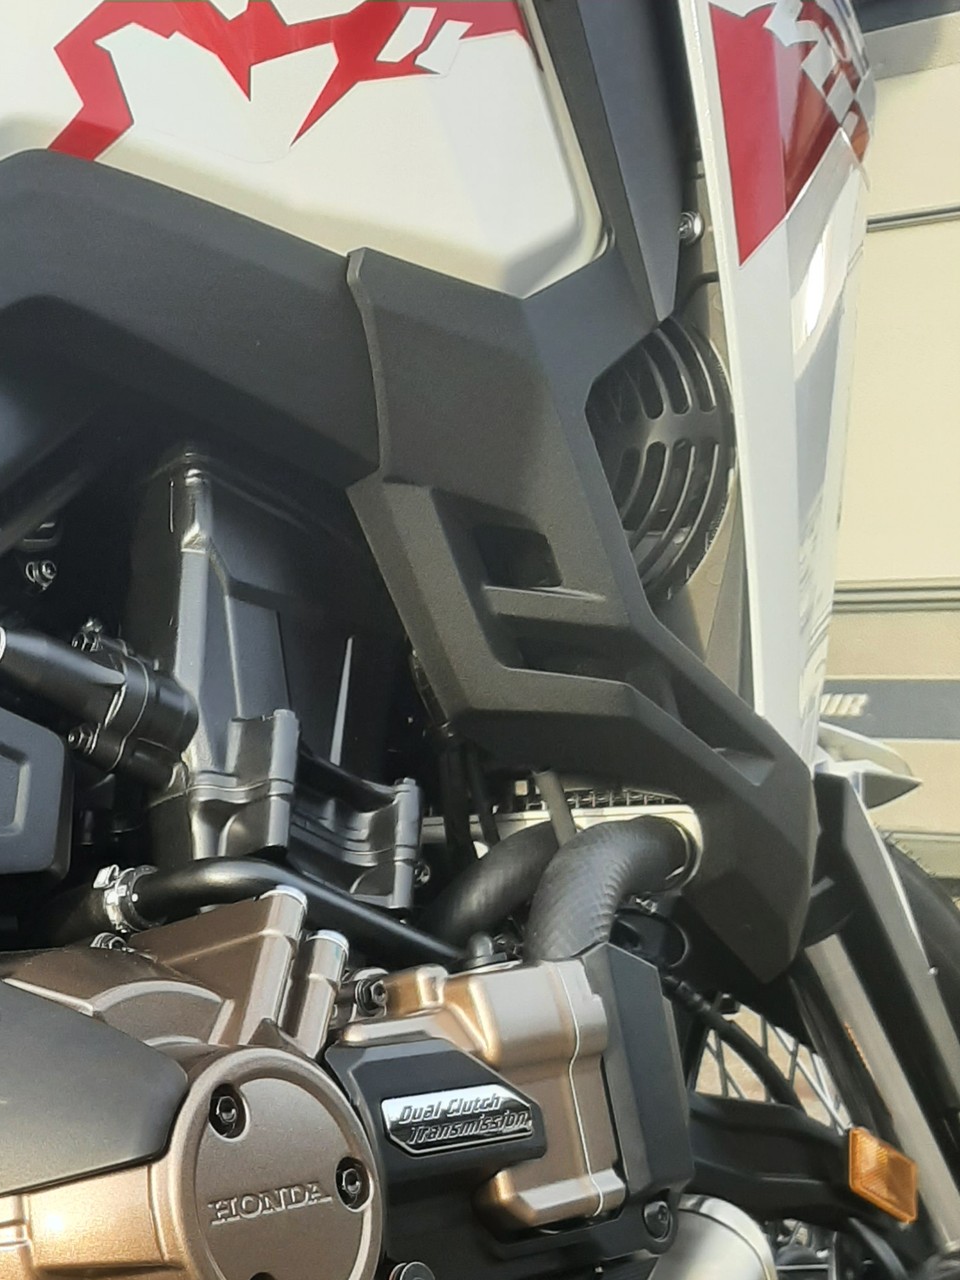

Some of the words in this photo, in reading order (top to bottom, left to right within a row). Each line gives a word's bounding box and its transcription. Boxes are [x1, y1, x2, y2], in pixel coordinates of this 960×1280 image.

[399, 1101, 441, 1124] Dual
[447, 1093, 502, 1117] Clutch
[407, 1110, 528, 1145] Transmission
[207, 1181, 333, 1225] HONDA
